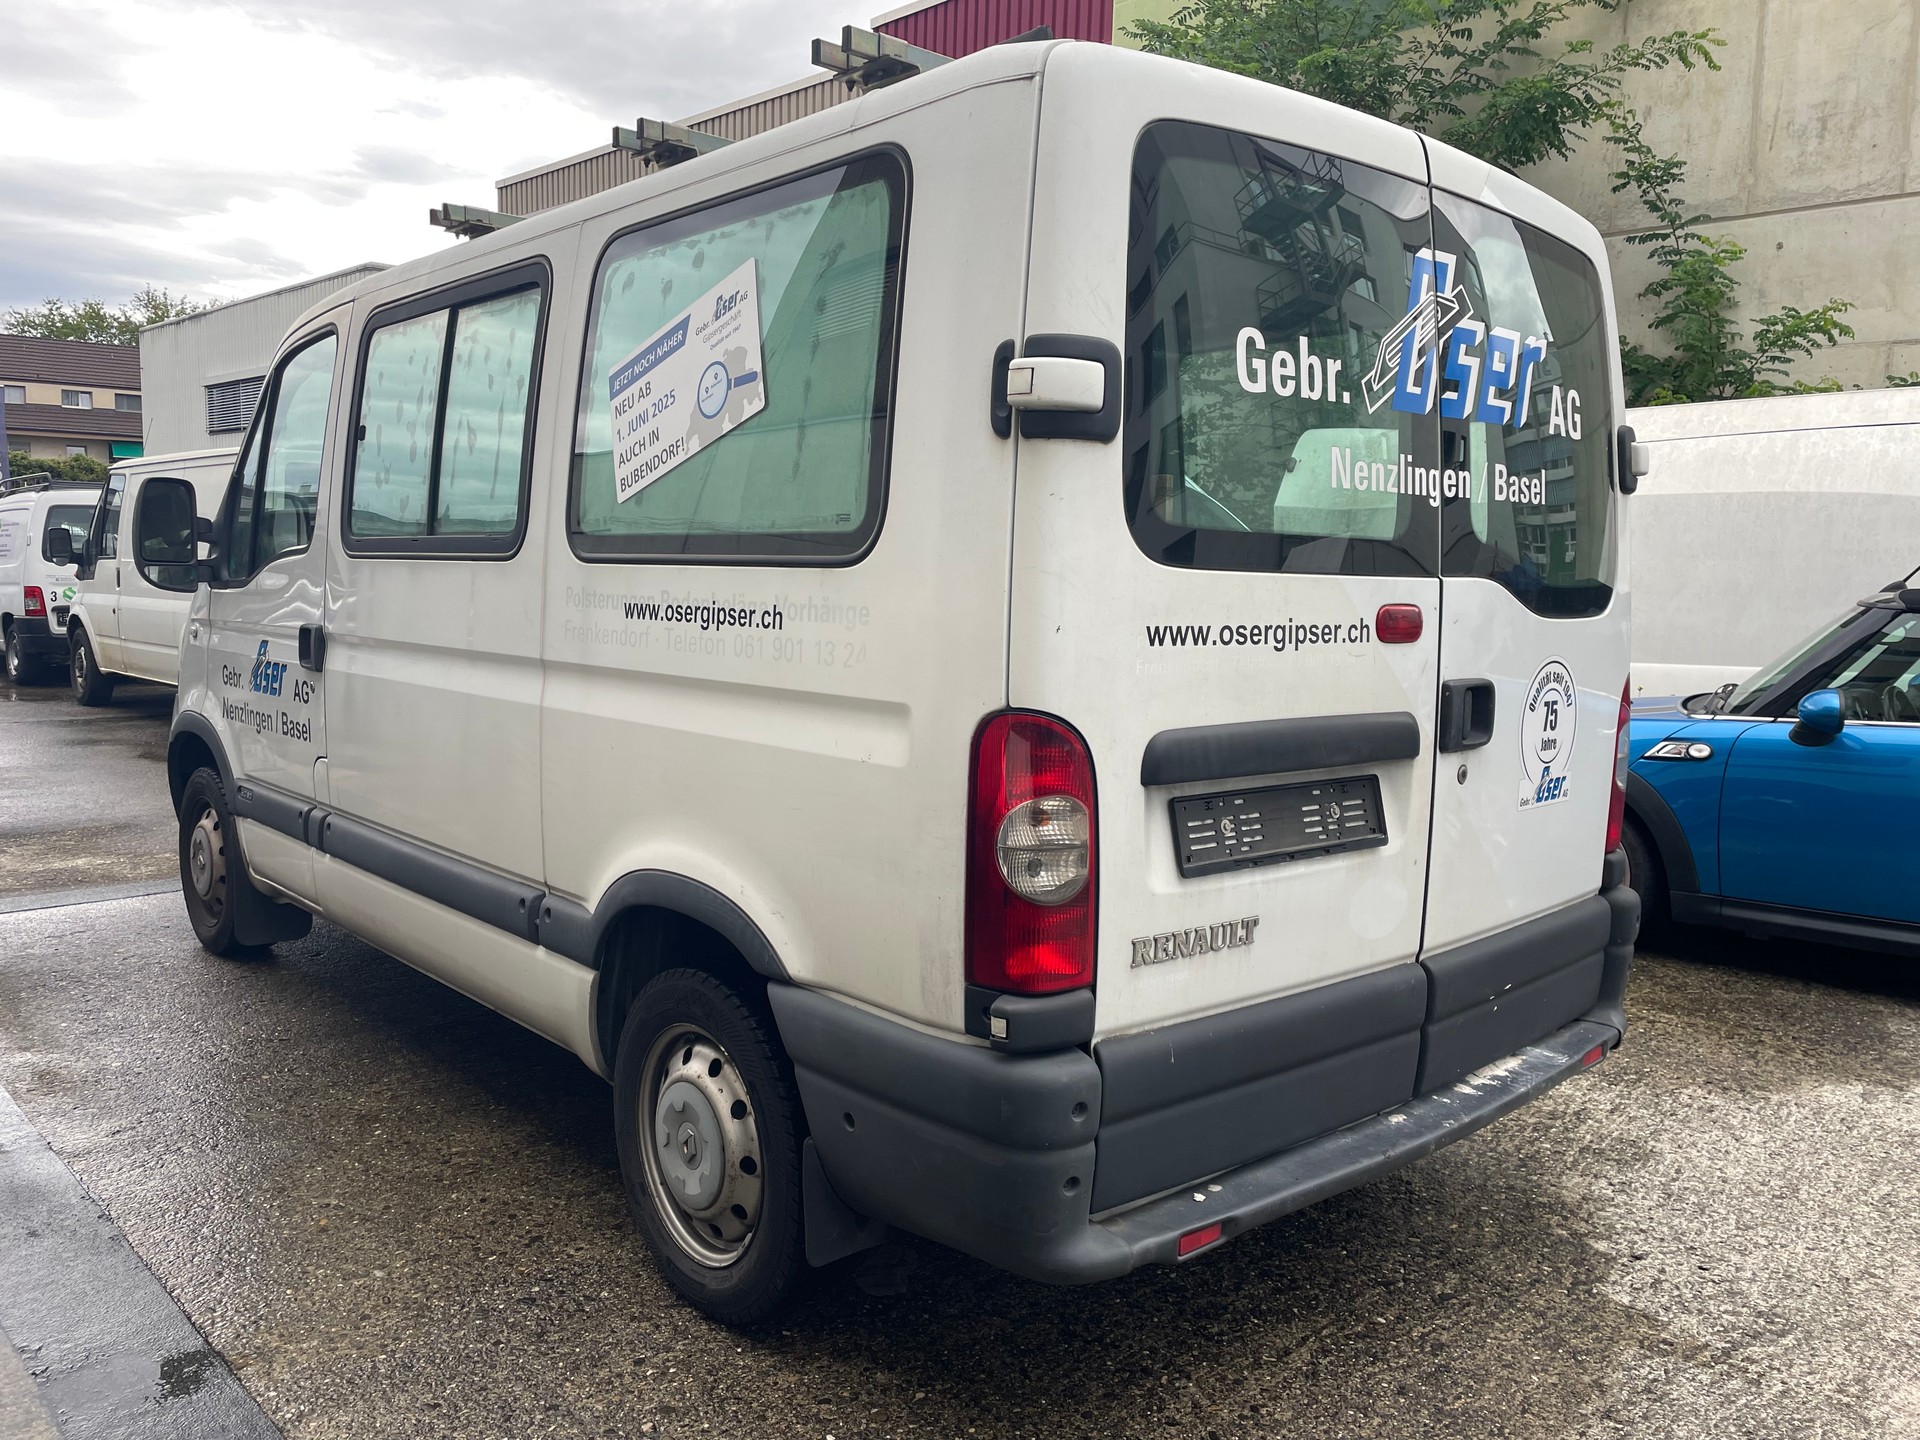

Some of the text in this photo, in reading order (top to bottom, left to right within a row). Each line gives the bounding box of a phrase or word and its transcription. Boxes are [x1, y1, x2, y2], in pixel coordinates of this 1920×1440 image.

[696, 321, 710, 336] Gebr.
[738, 290, 748, 304] AG
[702, 309, 742, 344] Gipsergeschäft
[612, 330, 684, 392] JETZT NOCH NÄHER
[614, 381, 652, 420] NEU AB
[1236, 327, 1351, 404] Gebr.
[1548, 384, 1582, 440] AG
[616, 388, 676, 442] 1. JUNI 2025
[618, 426, 660, 468] AUCH IN
[620, 436, 685, 492] BUBENDORF!
[1330, 446, 1471, 508] Nenzlingen
[1494, 468, 1546, 506] Basel
[50, 591, 57, 602] 3
[624, 600, 783, 630] www.osergipser.ch
[564, 620, 650, 648] Frenkendorf
[664, 627, 726, 656] Telefon
[734, 634, 763, 659] 061
[772, 636, 803, 663] 901
[814, 639, 835, 667] 13
[1146, 616, 1370, 652] www.osergipser.ch
[222, 664, 244, 690] Gebr.
[293, 679, 310, 704] AG
[1529, 671, 1572, 713] Qualität seit 1947
[222, 696, 273, 734] Nenzlingen
[281, 712, 311, 742] Basel
[1543, 700, 1558, 732] 75
[1540, 737, 1557, 752] Jahre
[1130, 915, 1260, 968] RENAULT
